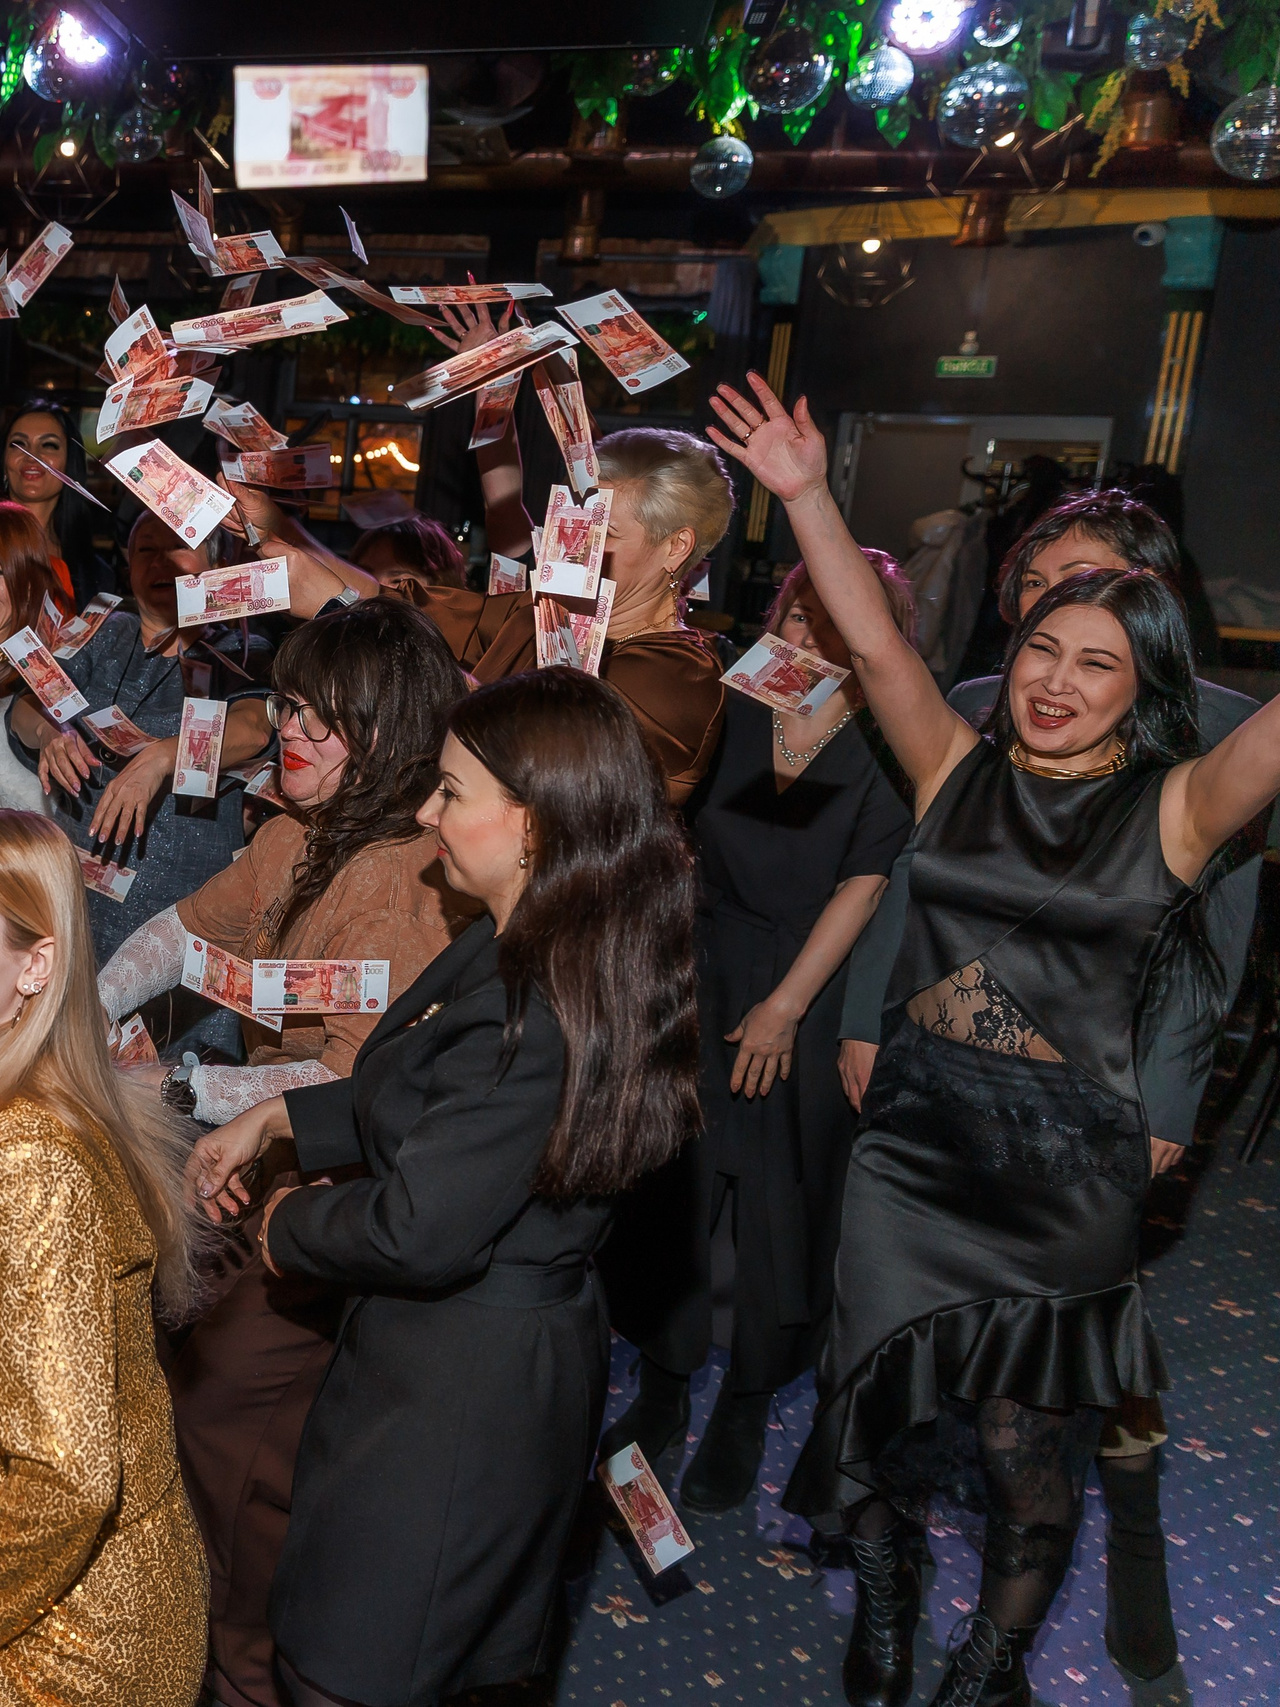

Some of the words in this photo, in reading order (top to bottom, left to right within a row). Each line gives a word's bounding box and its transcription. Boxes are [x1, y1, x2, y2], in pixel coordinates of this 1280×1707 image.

[192, 317, 225, 330] 5000
[161, 506, 183, 528] 5000
[592, 501, 606, 526] 5000
[247, 597, 274, 611] 5000
[594, 595, 609, 625] 5000
[770, 644, 797, 663] 5000
[212, 713, 221, 737] 5000
[333, 1000, 360, 1009] 5000
[637, 1528, 656, 1555] 5000
